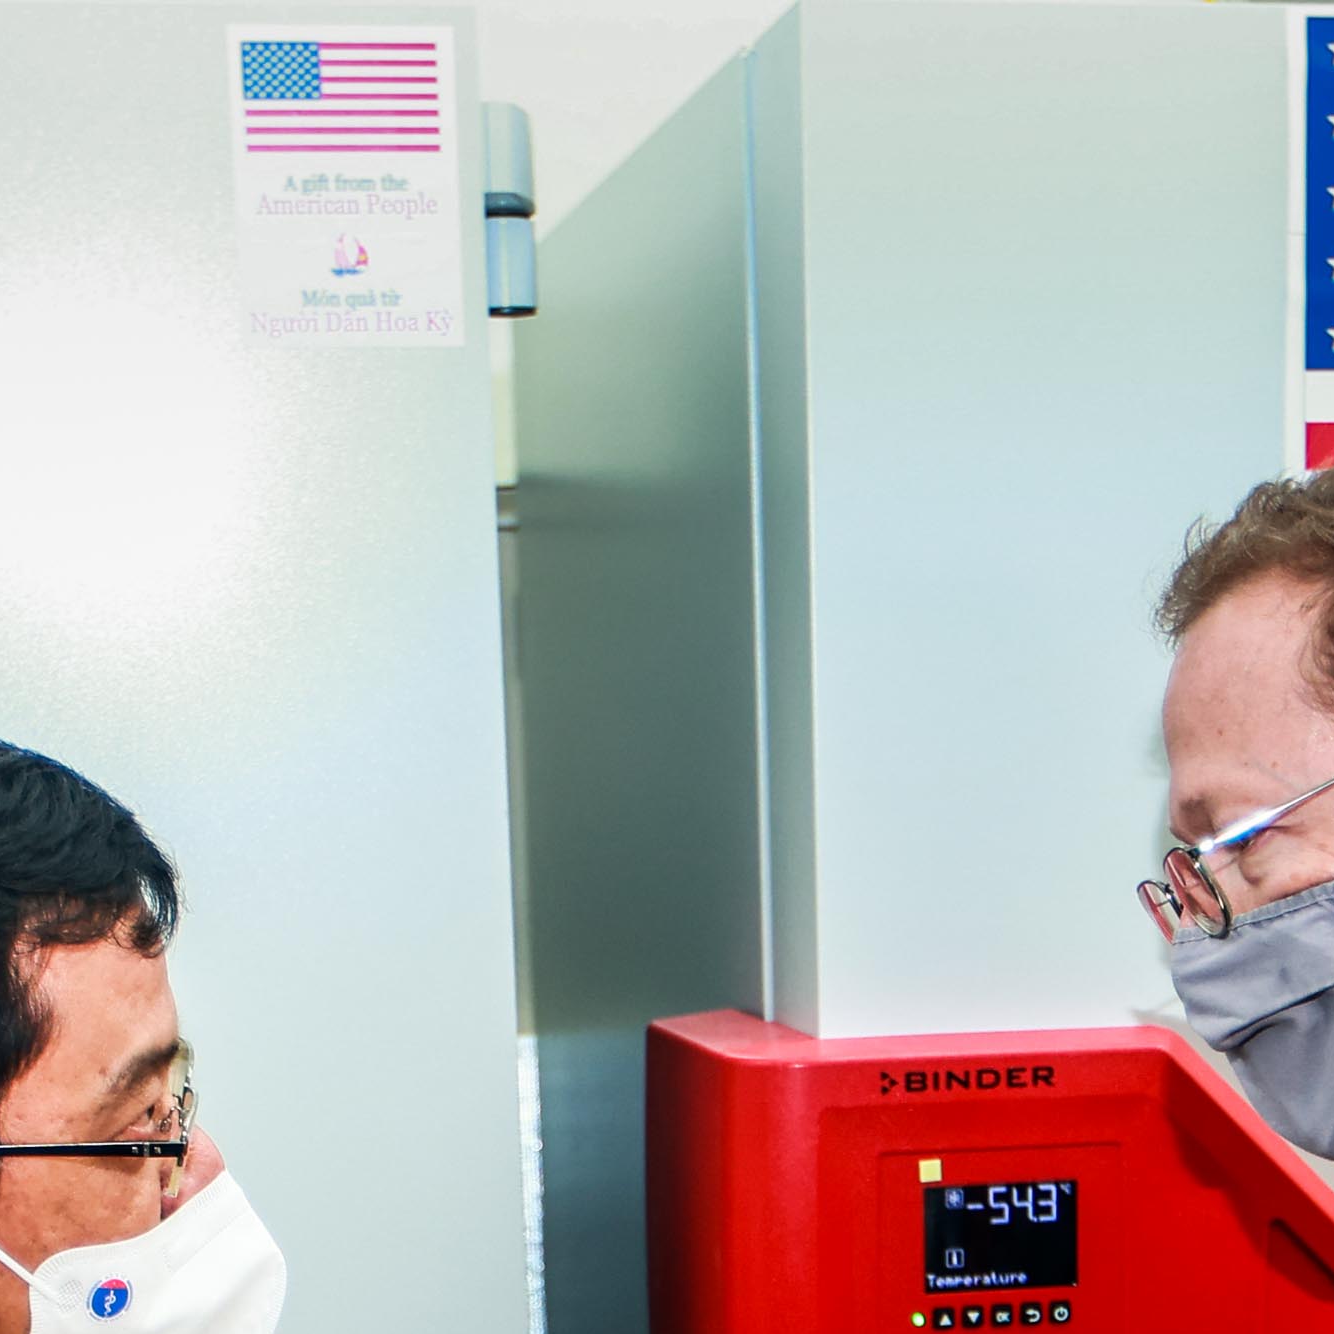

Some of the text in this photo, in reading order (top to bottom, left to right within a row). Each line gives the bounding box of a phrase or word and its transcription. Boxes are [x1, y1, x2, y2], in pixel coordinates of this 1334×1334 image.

[283, 173, 408, 195] A gift from the
[256, 192, 438, 219] American People
[325, 309, 369, 332] Dân
[375, 311, 419, 332] Hoa
[904, 1066, 1056, 1093] BINDER
[926, 1271, 1028, 1289] Temperature
